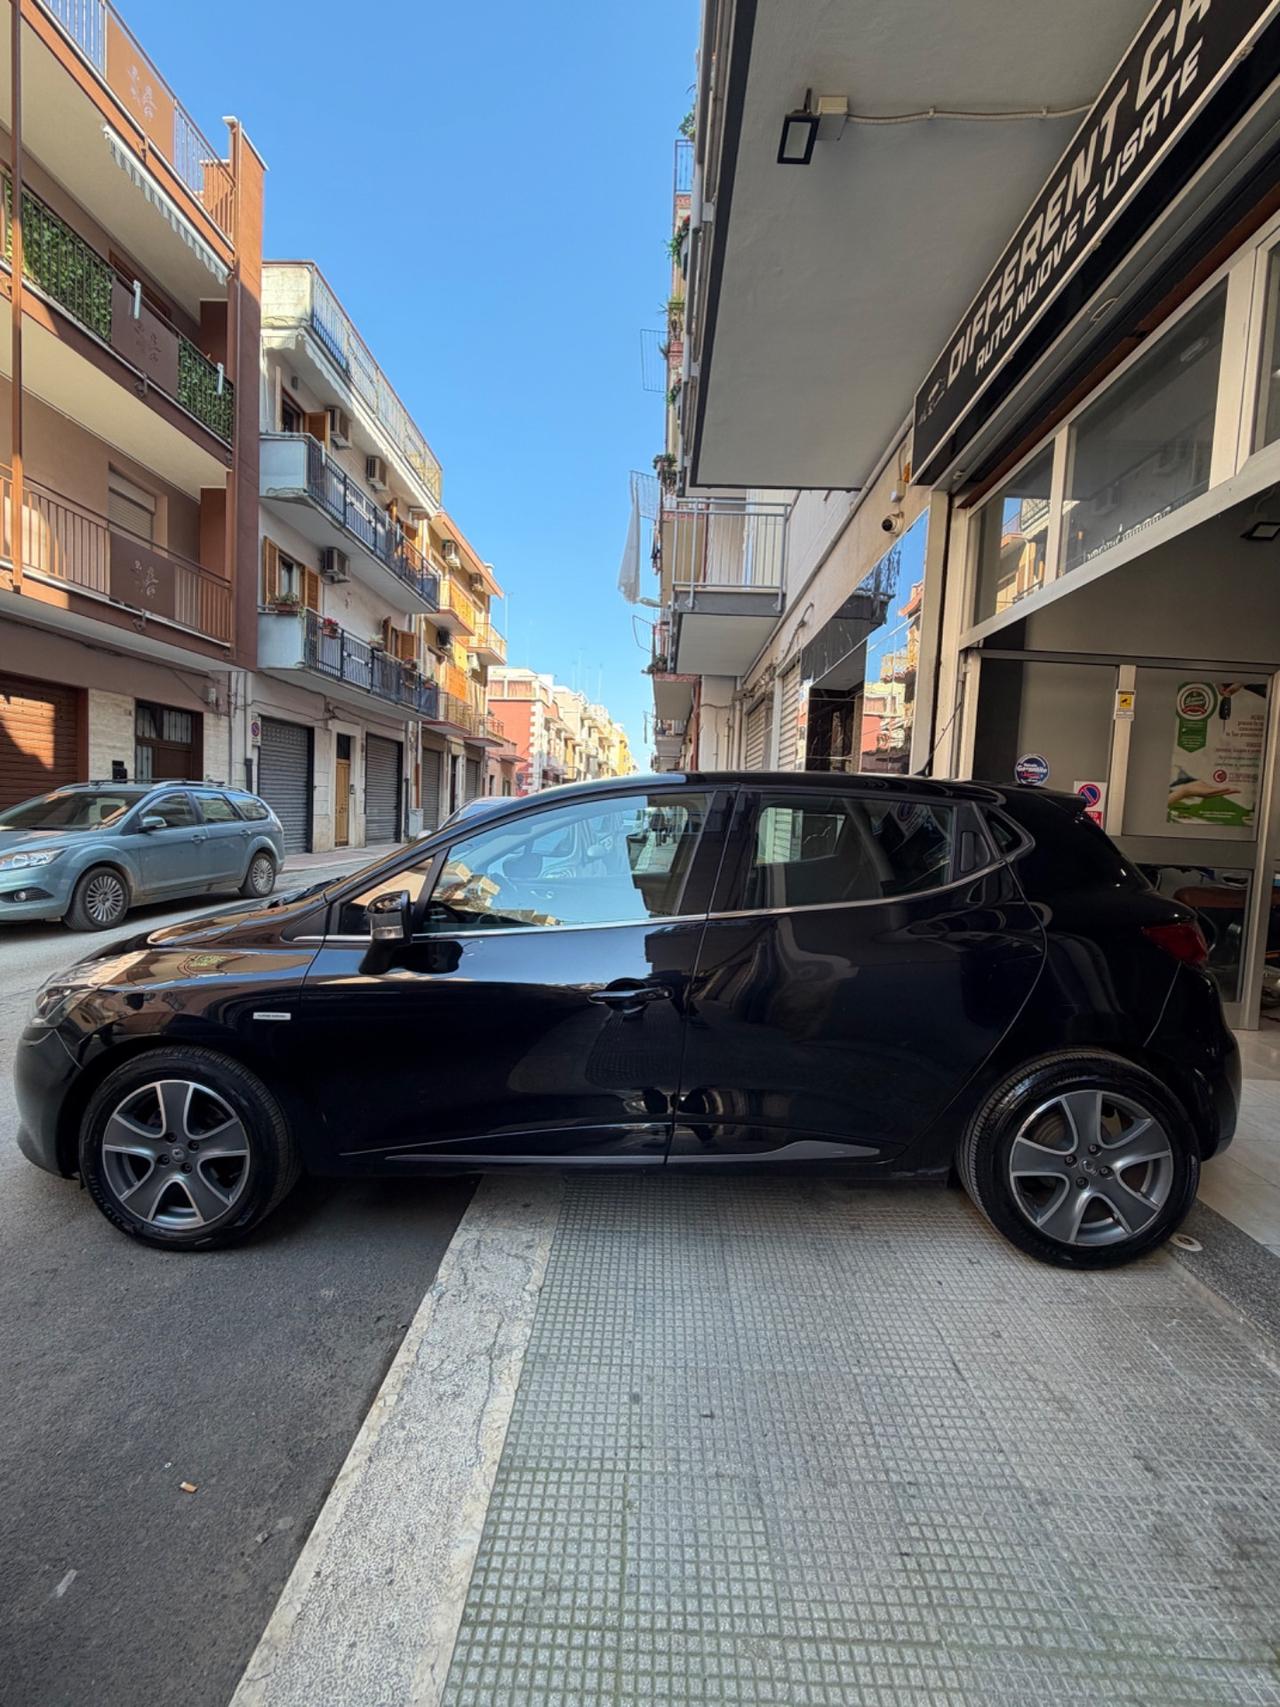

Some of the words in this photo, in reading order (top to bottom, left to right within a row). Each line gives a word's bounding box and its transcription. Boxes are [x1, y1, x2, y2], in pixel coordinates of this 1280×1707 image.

[947, 78, 1129, 389] DIFFERENT
[975, 313, 1014, 376] AUTO
[1013, 217, 1079, 327] NUOVE
[1083, 184, 1099, 231] E
[1102, 36, 1204, 202] USATE
